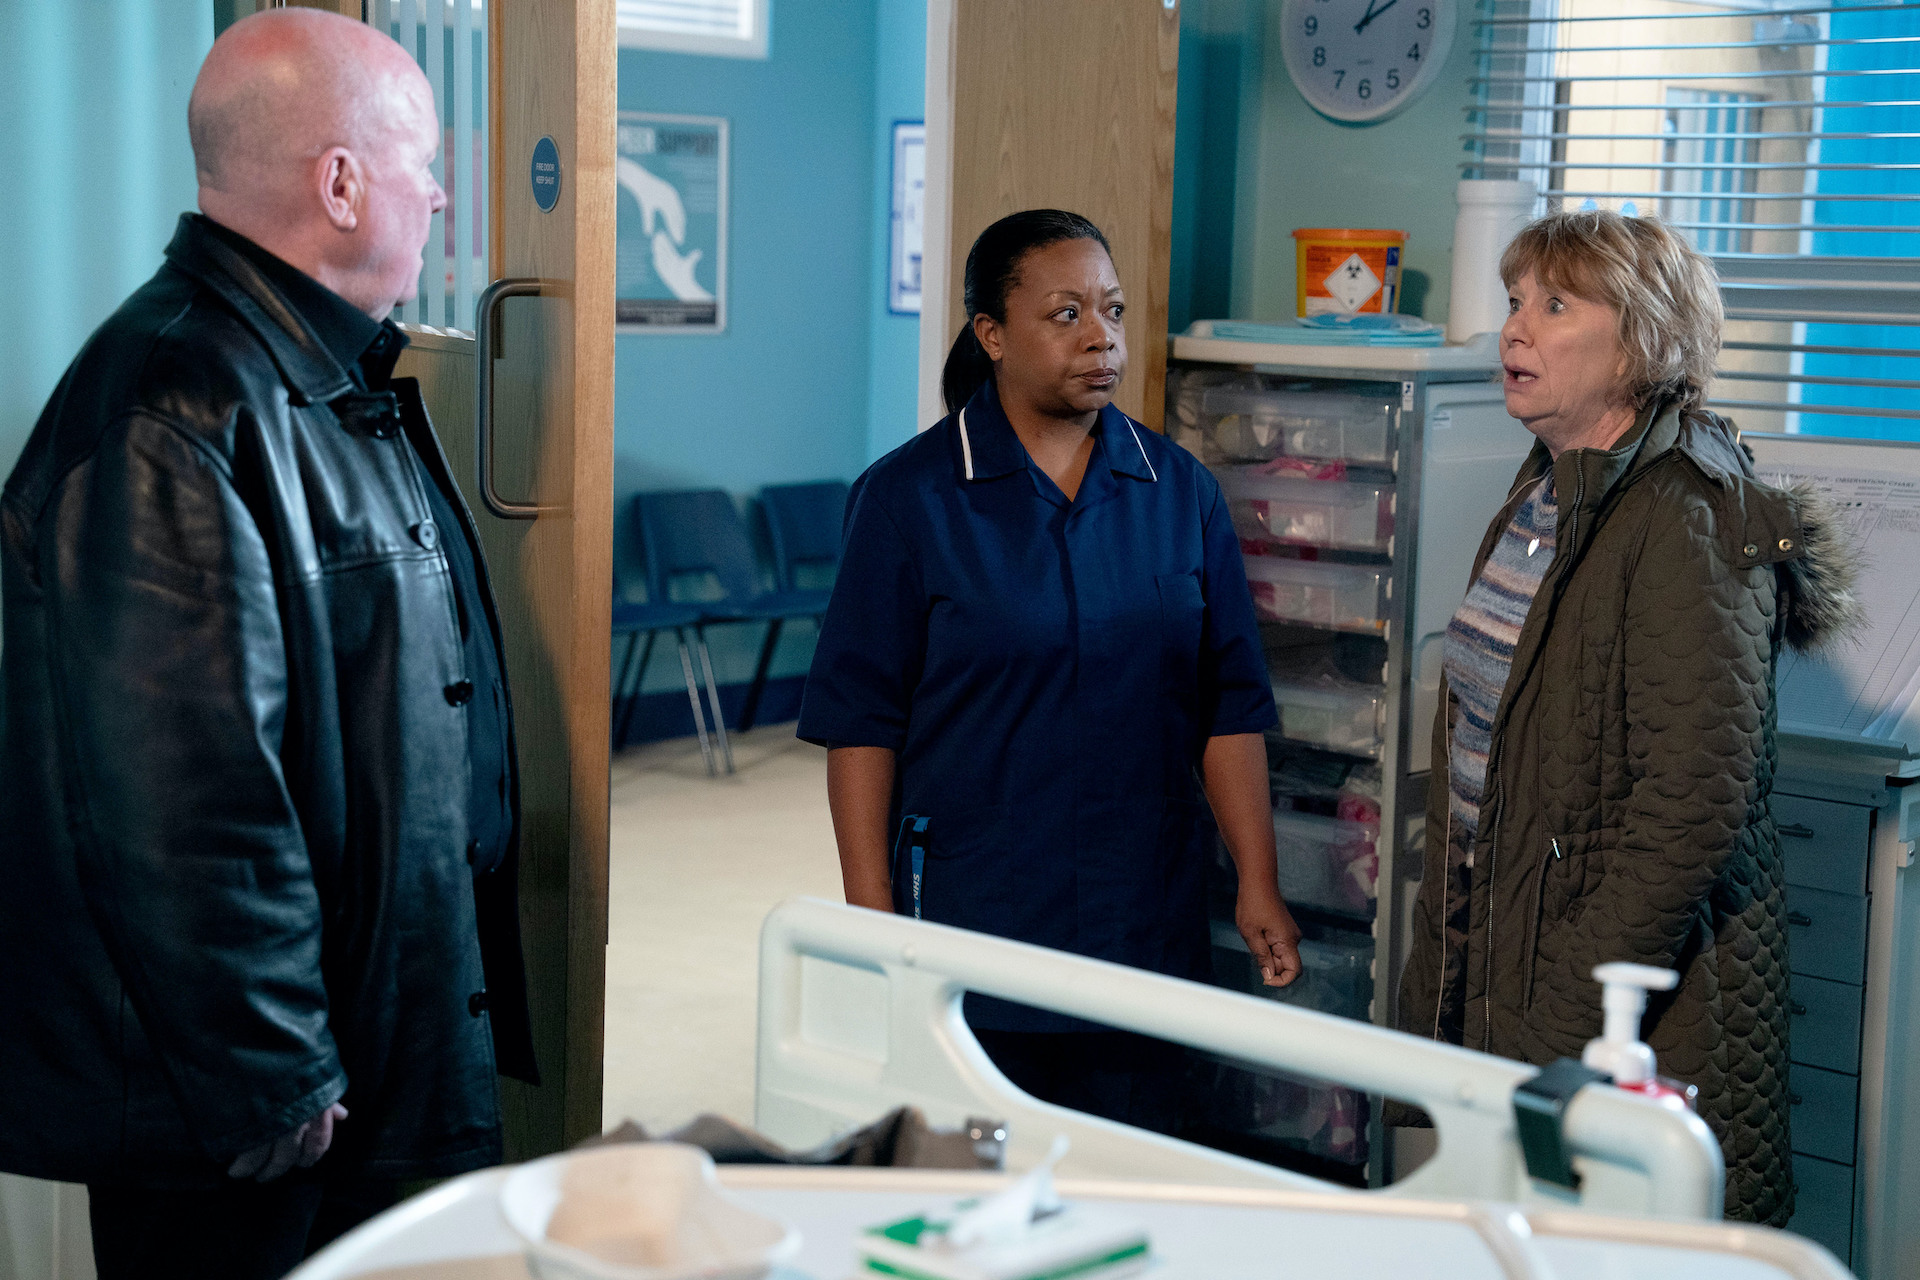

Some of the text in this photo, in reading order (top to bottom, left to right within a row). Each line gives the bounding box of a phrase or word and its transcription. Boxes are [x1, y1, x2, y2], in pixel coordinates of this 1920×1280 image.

[1304, 15, 1318, 37] 9
[1416, 7, 1431, 30] 3
[1312, 46, 1326, 67] 8
[1406, 42, 1420, 62] 4
[1333, 69, 1347, 90] 7
[1357, 78, 1372, 100] 6
[1385, 68, 1400, 90] 5
[536, 162, 555, 172] FIRE DOOR
[1836, 476, 1888, 486] OBSERVATION
[1888, 480, 1915, 488] CHART
